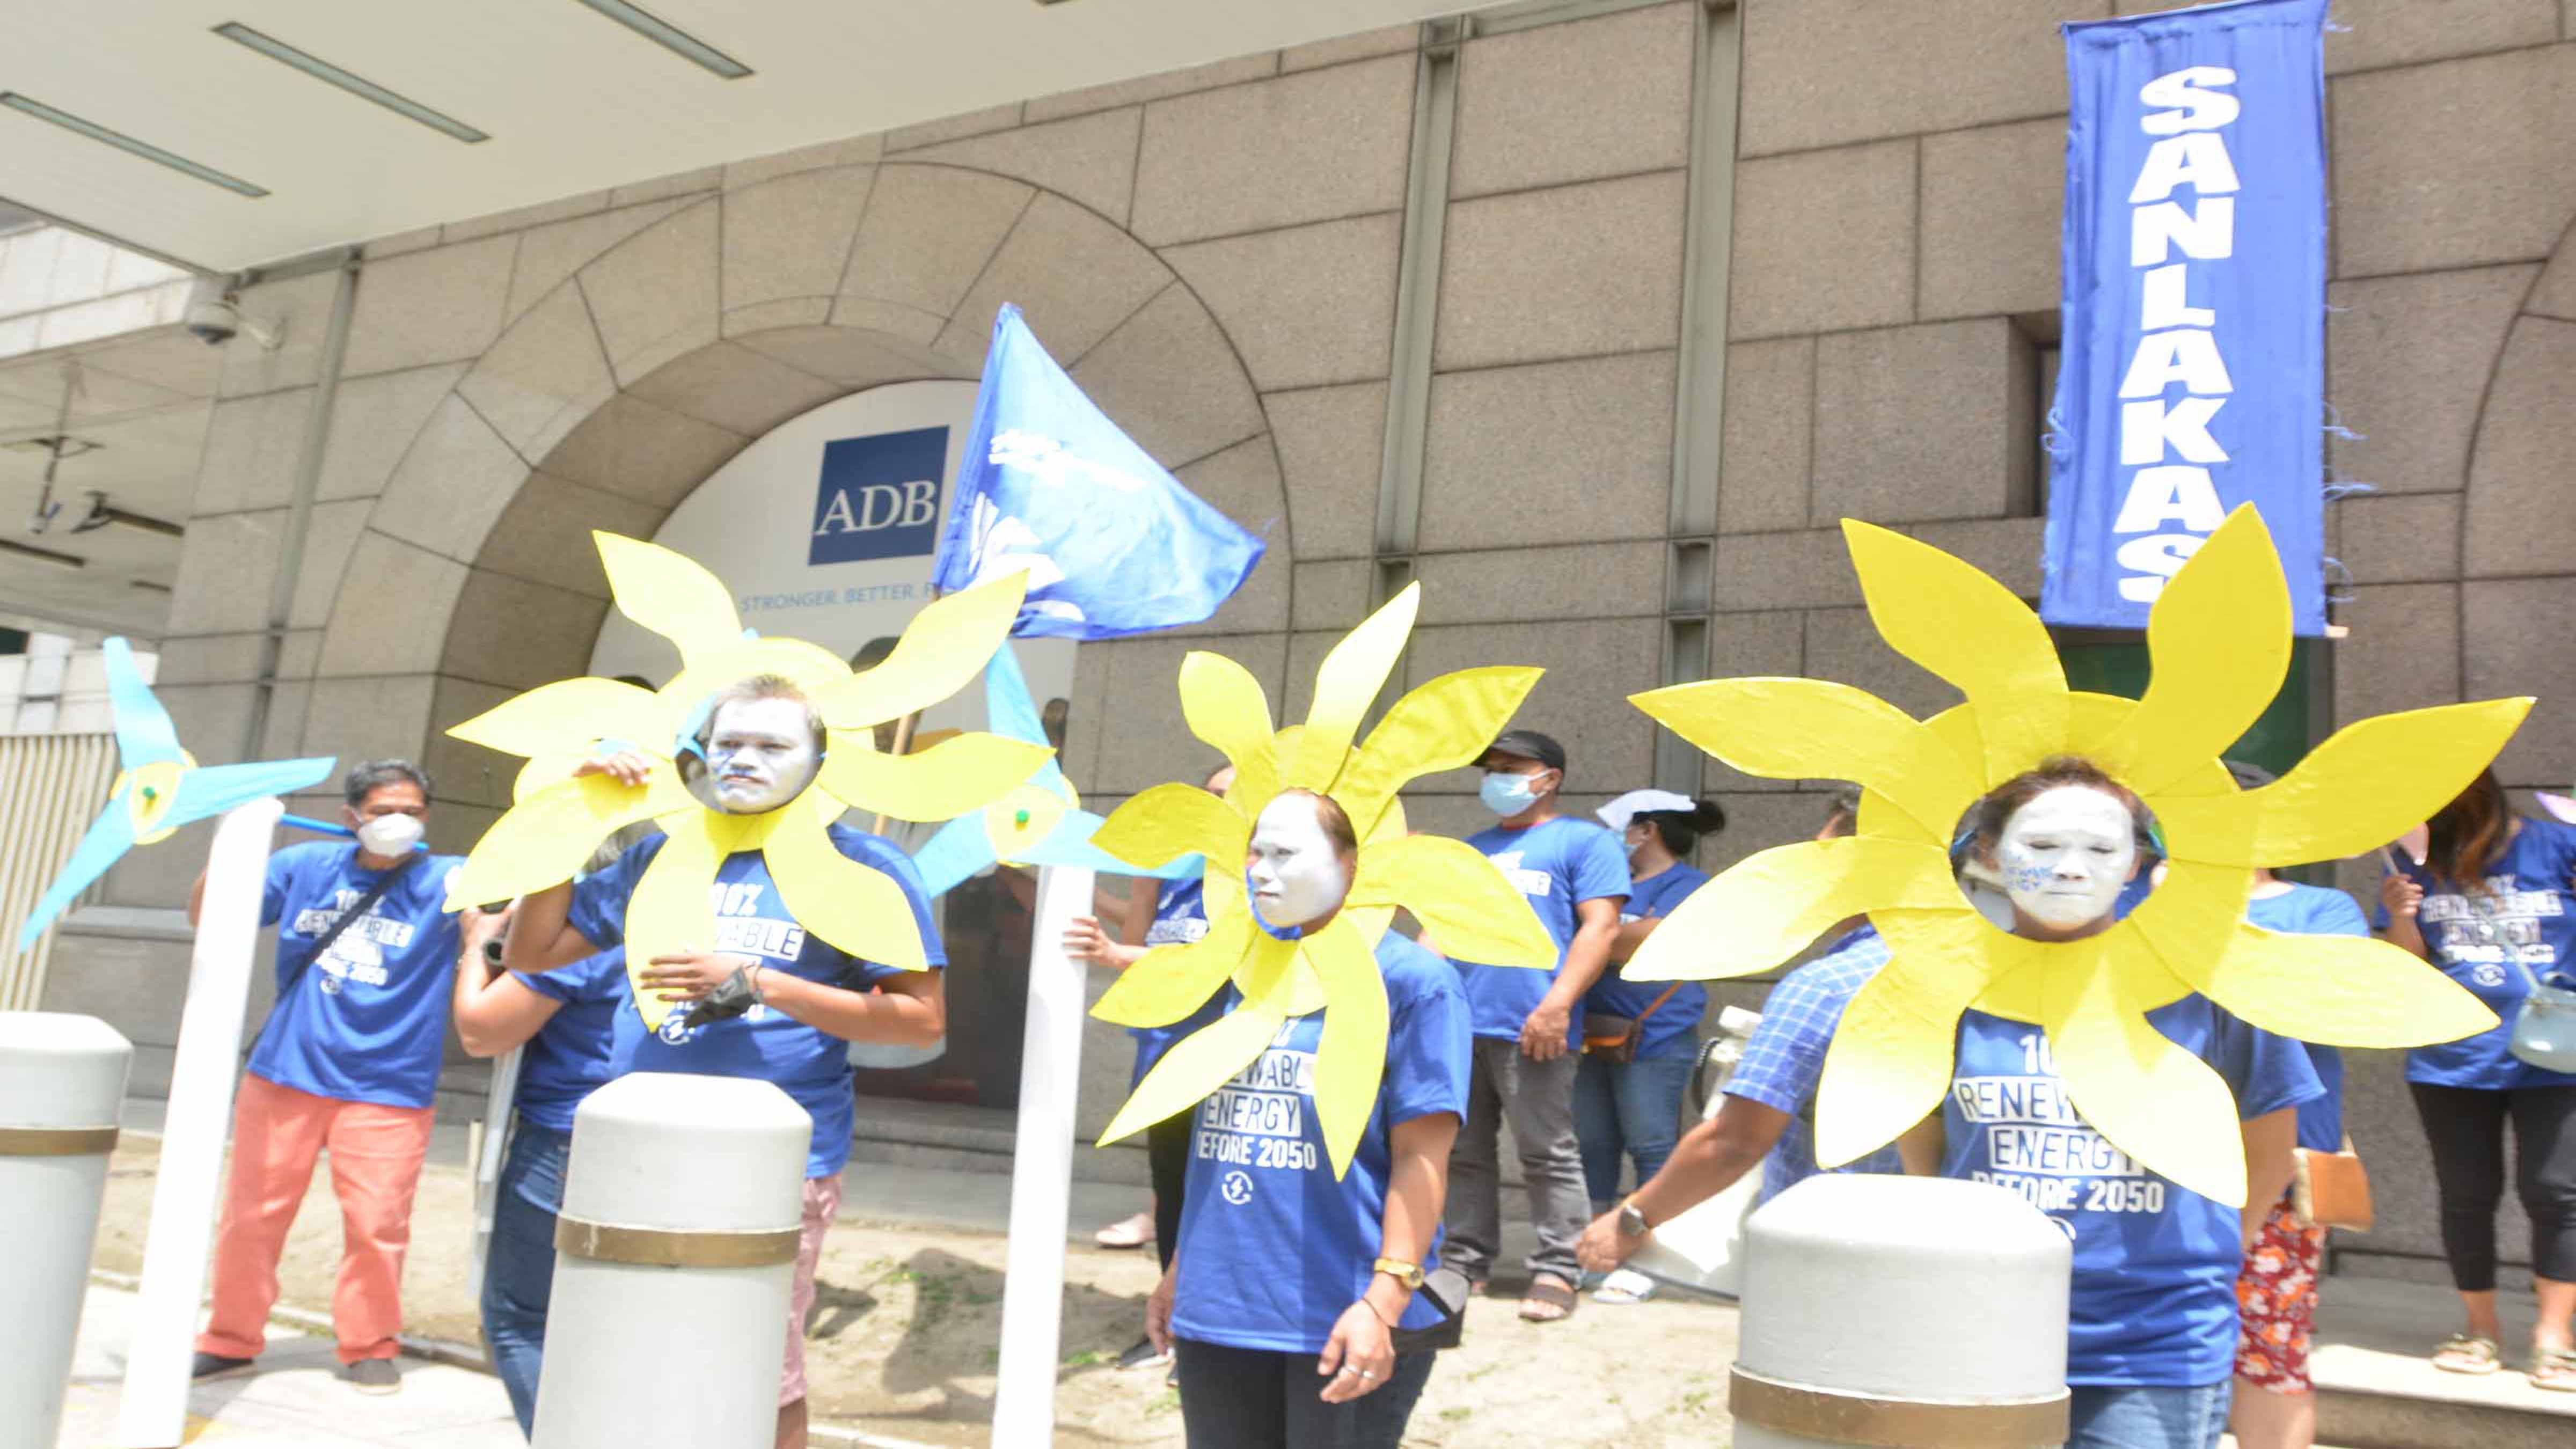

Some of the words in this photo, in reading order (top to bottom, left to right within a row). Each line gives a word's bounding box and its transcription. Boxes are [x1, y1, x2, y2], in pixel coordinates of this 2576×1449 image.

[2112, 65, 2241, 603] SANLAKAS
[813, 479, 936, 536] ADB
[1204, 1092, 1298, 1132] ENERGY
[1256, 1137, 1317, 1170] 2050
[2084, 1180, 2164, 1213] 2050
